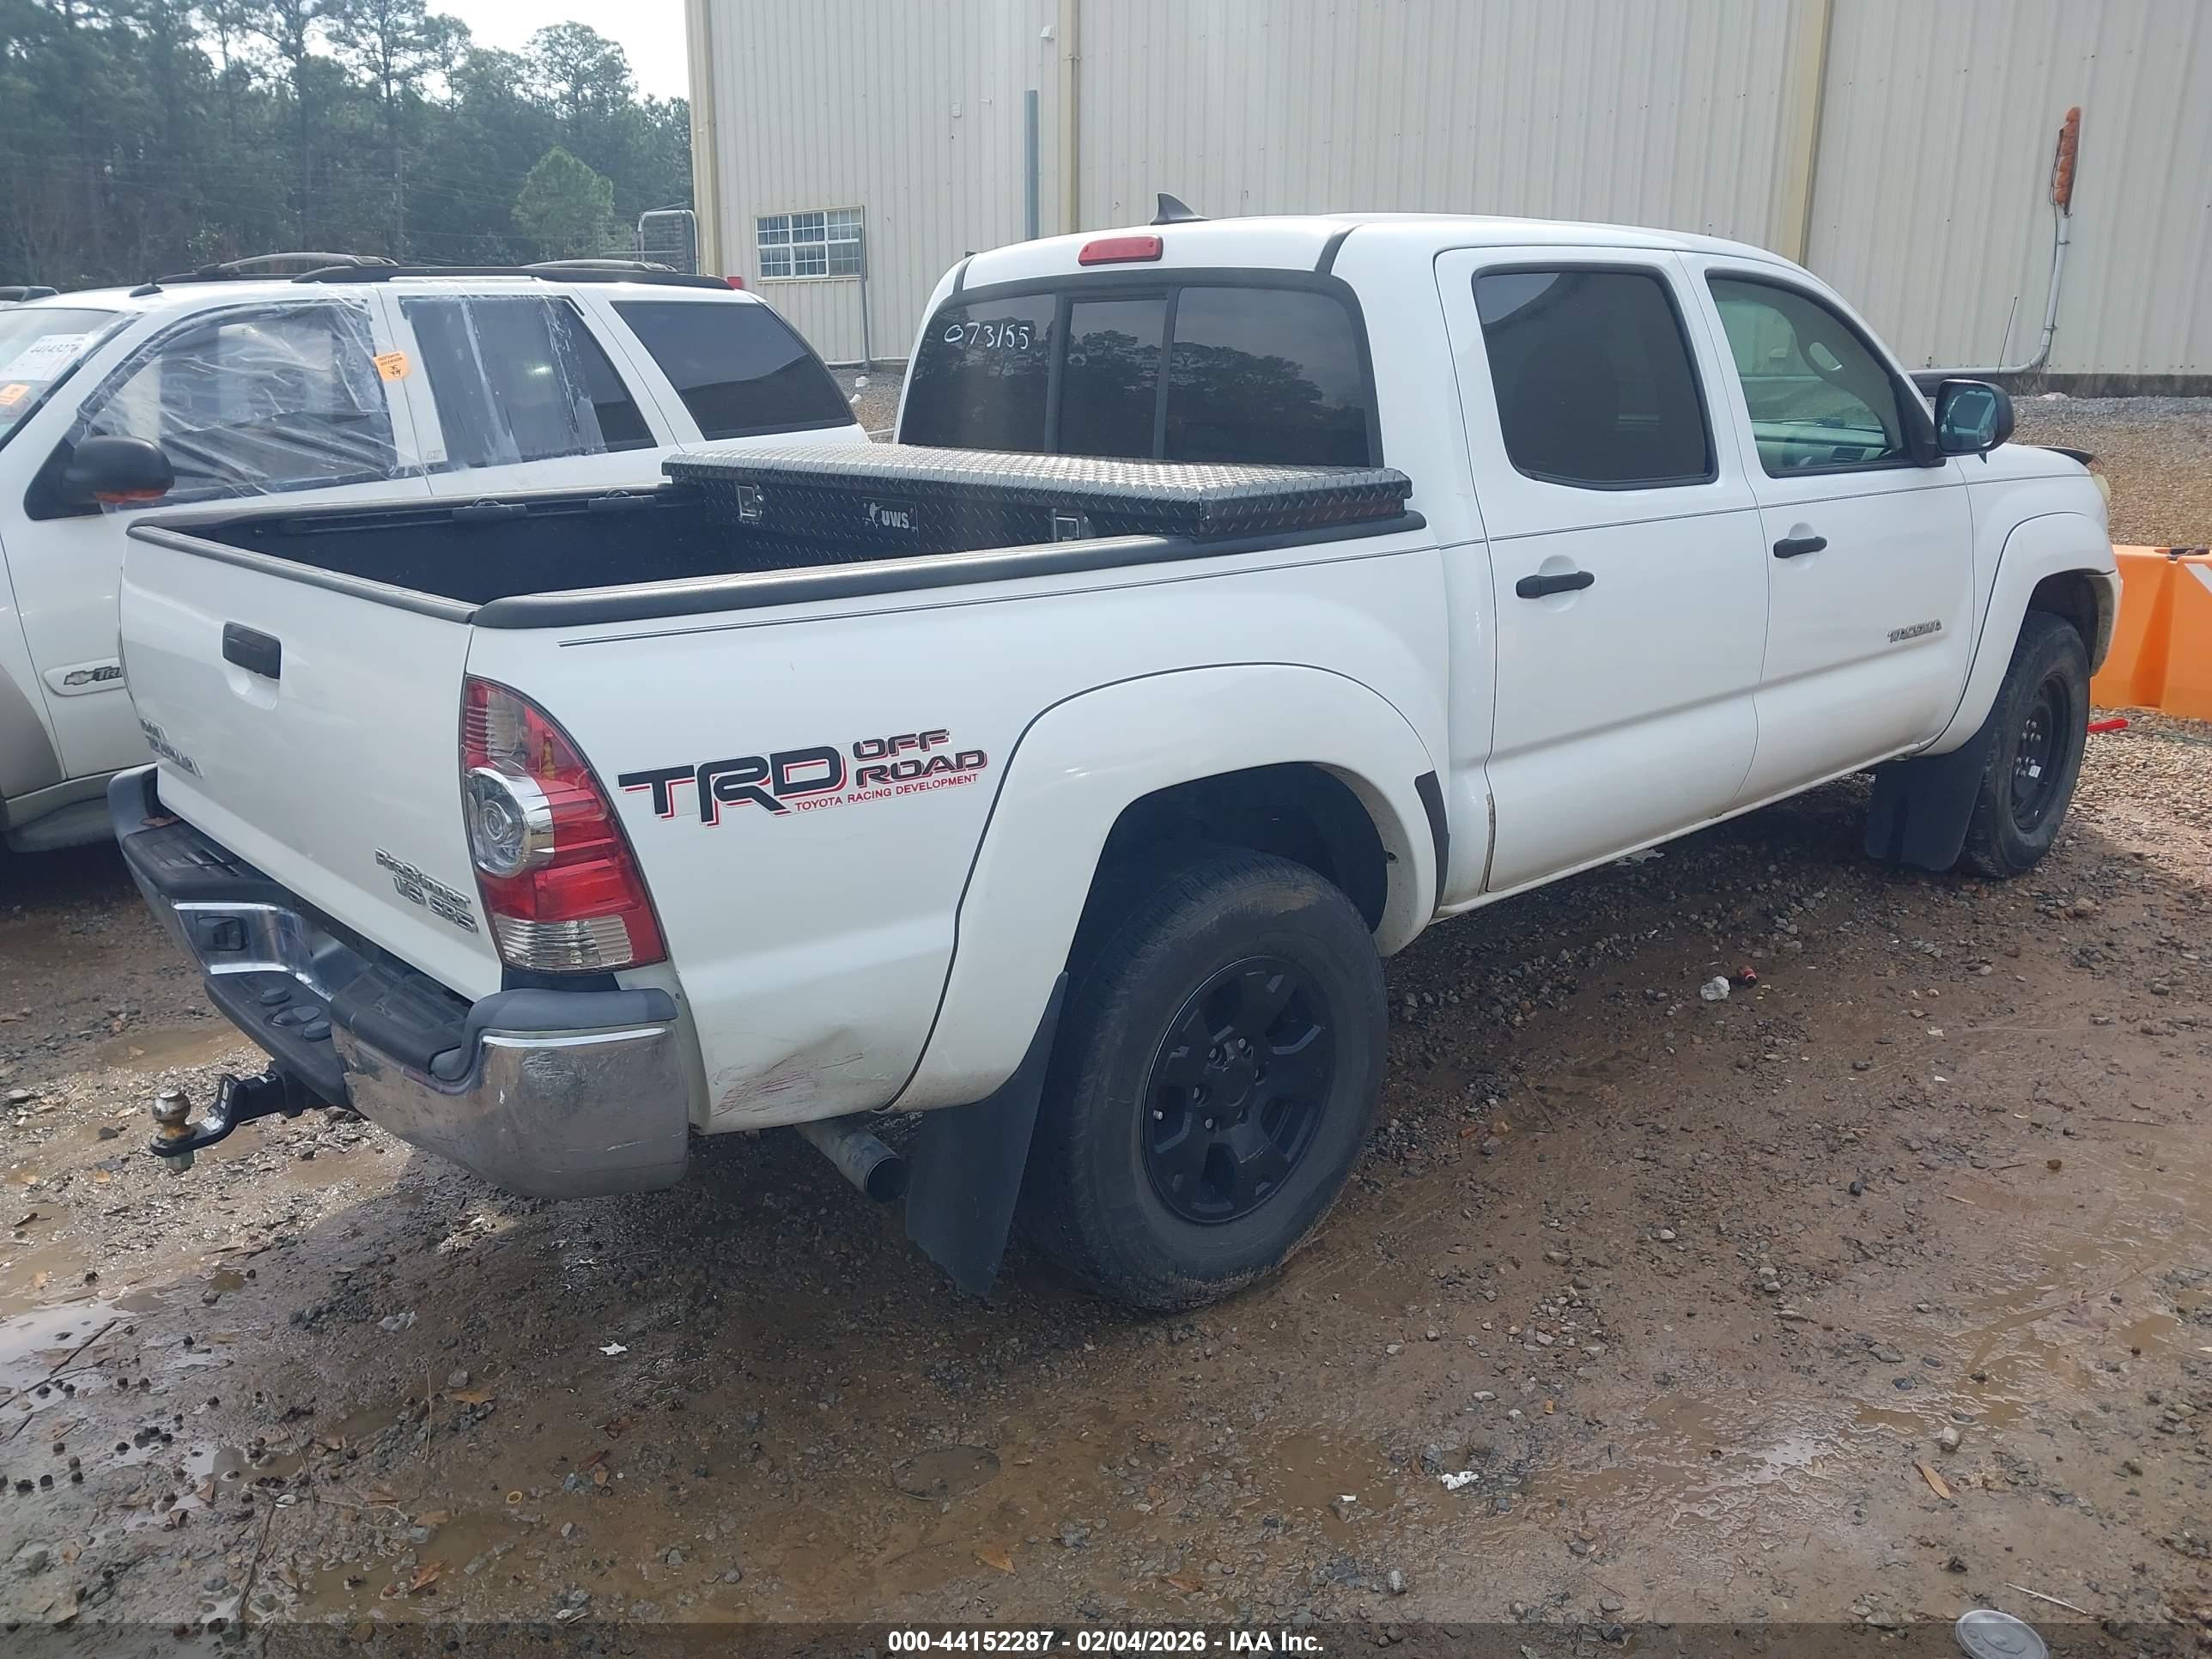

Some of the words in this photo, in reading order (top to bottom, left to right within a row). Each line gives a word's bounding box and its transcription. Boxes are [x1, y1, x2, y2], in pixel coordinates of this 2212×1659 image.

[943, 321, 1030, 350] 073155
[881, 510, 909, 529] UWS
[853, 728, 951, 761] OFF
[617, 745, 847, 828] TRD
[856, 749, 989, 788] ROAD
[795, 796, 843, 811] TOYOTA
[848, 787, 892, 804] RACING
[896, 774, 980, 795] DEVELOPMENT
[392, 874, 426, 905] V6
[428, 896, 479, 933] SR5
